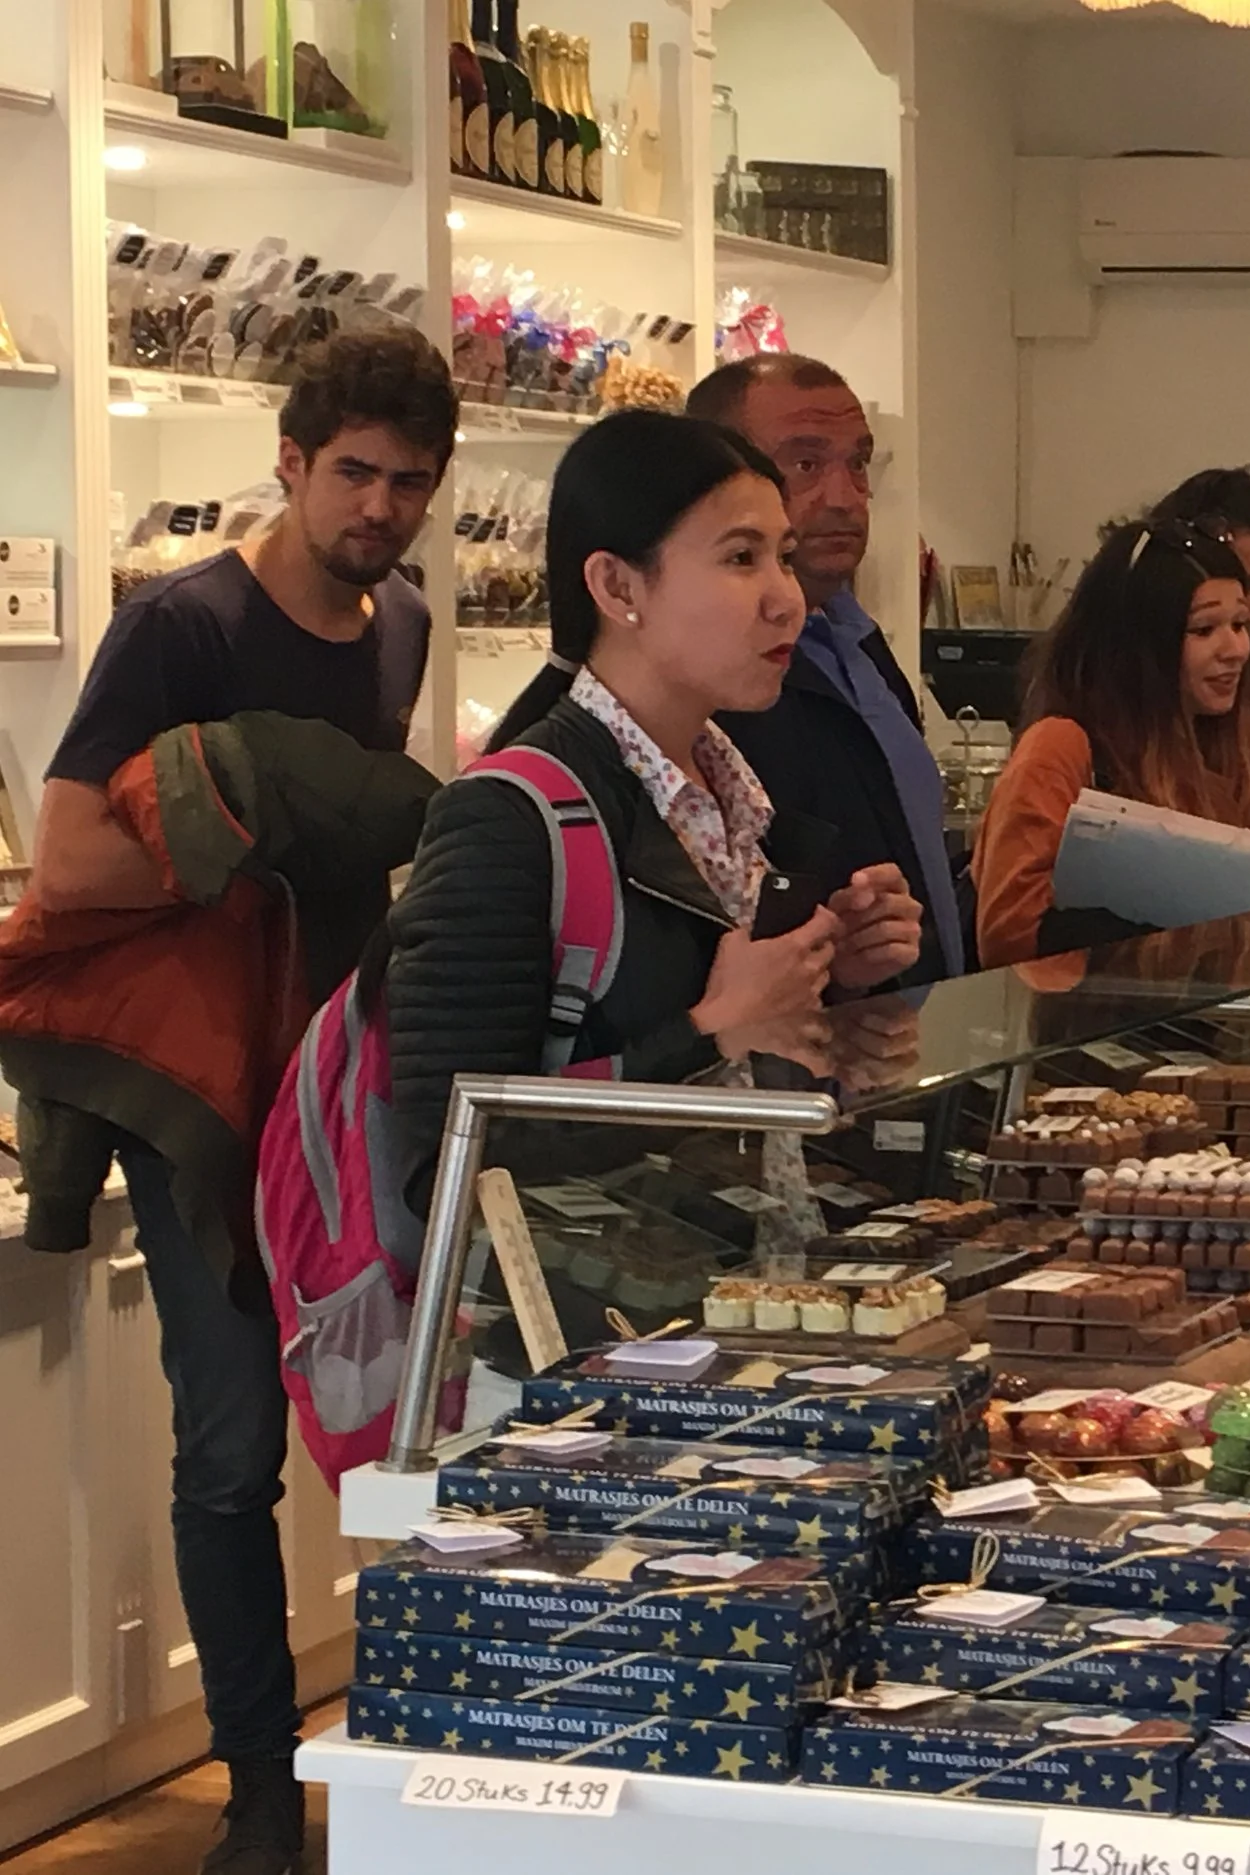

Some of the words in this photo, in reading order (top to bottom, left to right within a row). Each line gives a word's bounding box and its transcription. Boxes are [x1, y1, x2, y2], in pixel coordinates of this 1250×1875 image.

[636, 1397, 718, 1417] MATRASJES
[720, 1402, 747, 1417] OM
[556, 1486, 639, 1508] MATRASJES
[697, 1499, 749, 1516] DELEN
[480, 1592, 568, 1614] MATRASJES
[570, 1598, 599, 1615] OM
[628, 1604, 682, 1621] DELEN
[476, 1650, 562, 1673] MATRASJES
[565, 1658, 593, 1673] OM
[622, 1665, 676, 1682] DELEN
[468, 1709, 556, 1732] MATRASJES
[558, 1718, 586, 1734] OM
[590, 1721, 611, 1736] TE
[414, 1774, 456, 1801] 20
[535, 1779, 609, 1810] 14.99
[1050, 1840, 1090, 1874] 12
